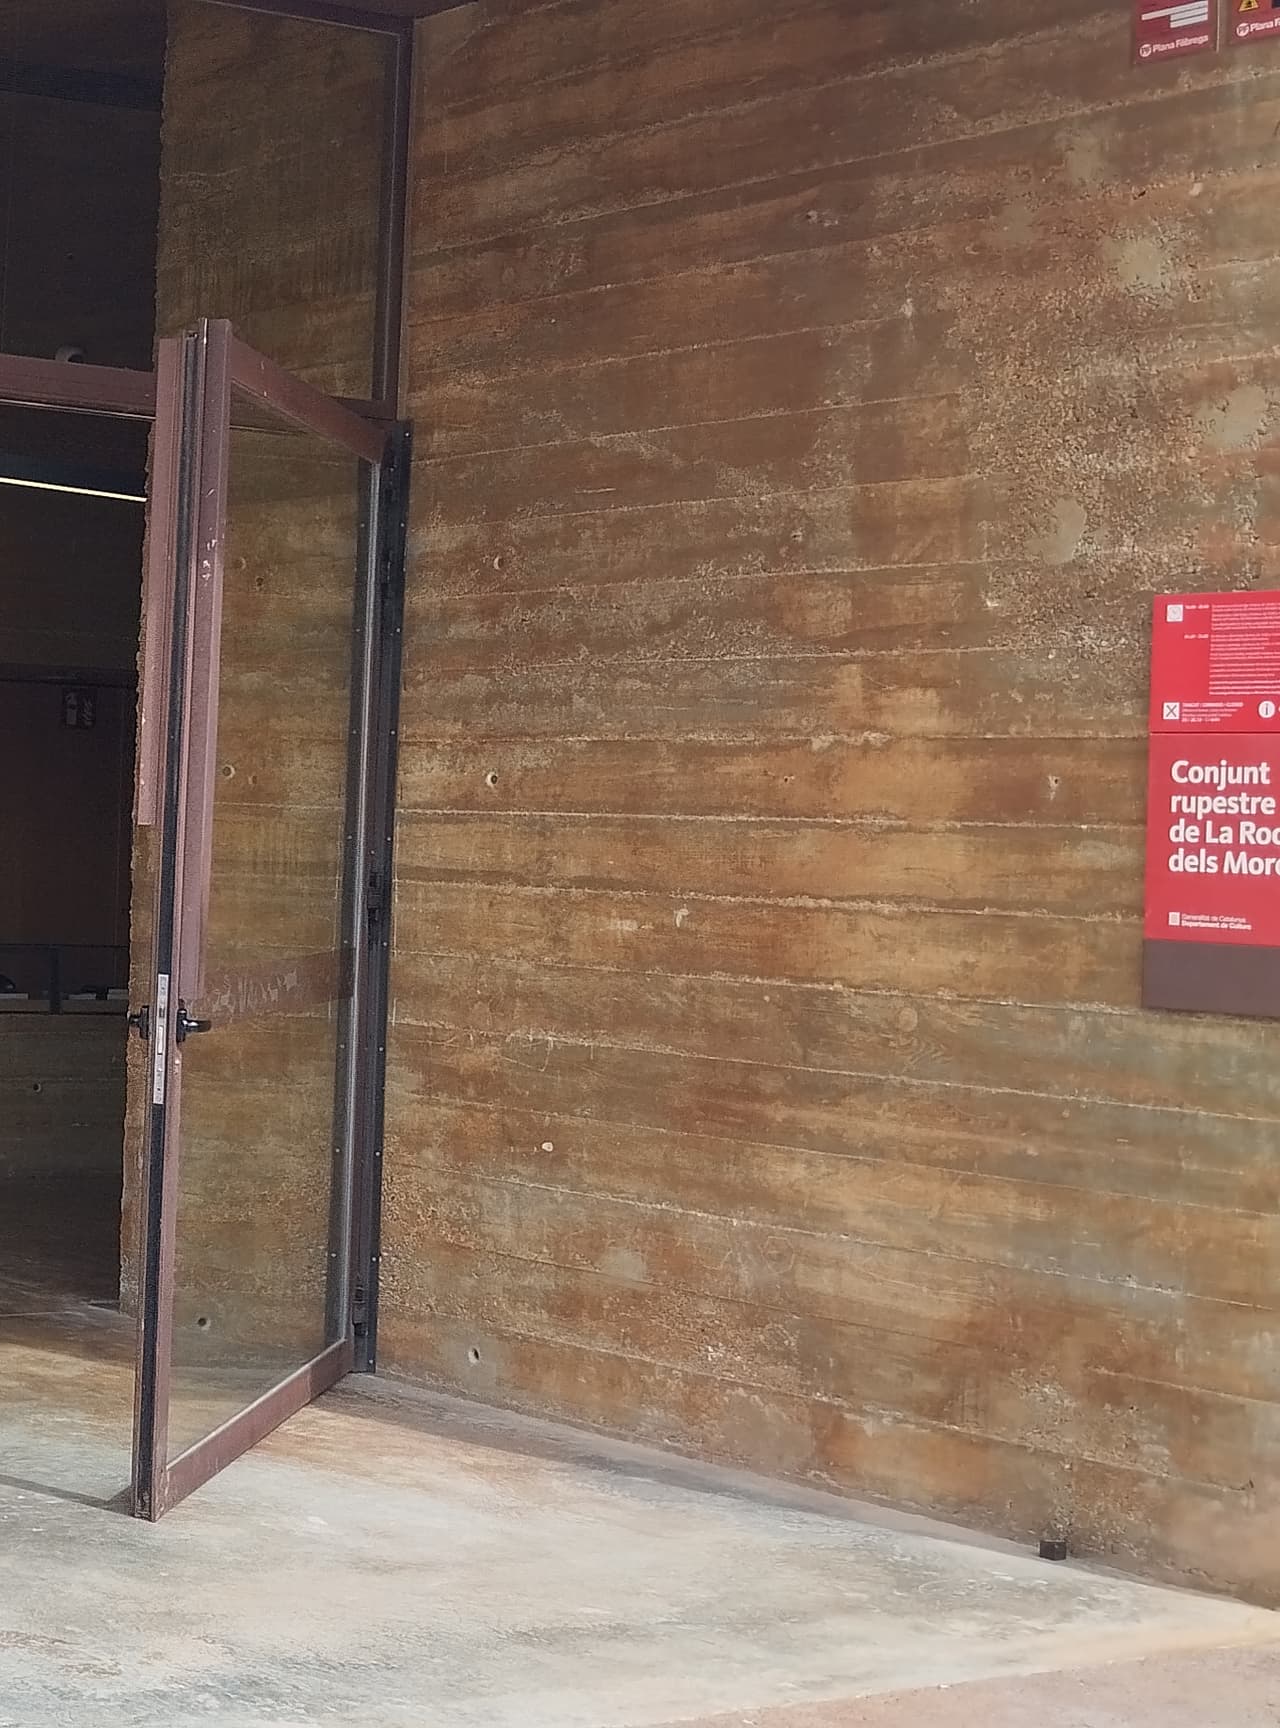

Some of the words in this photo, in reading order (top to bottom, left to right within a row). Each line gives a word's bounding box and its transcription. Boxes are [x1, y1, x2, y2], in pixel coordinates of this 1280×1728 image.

[1152, 42, 1175, 53] Plana
[1171, 759, 1271, 790] Conjunt
[1169, 792, 1276, 820] rupestre
[1169, 818, 1200, 844] de
[1205, 820, 1233, 844] La
[1168, 848, 1218, 874] dels
